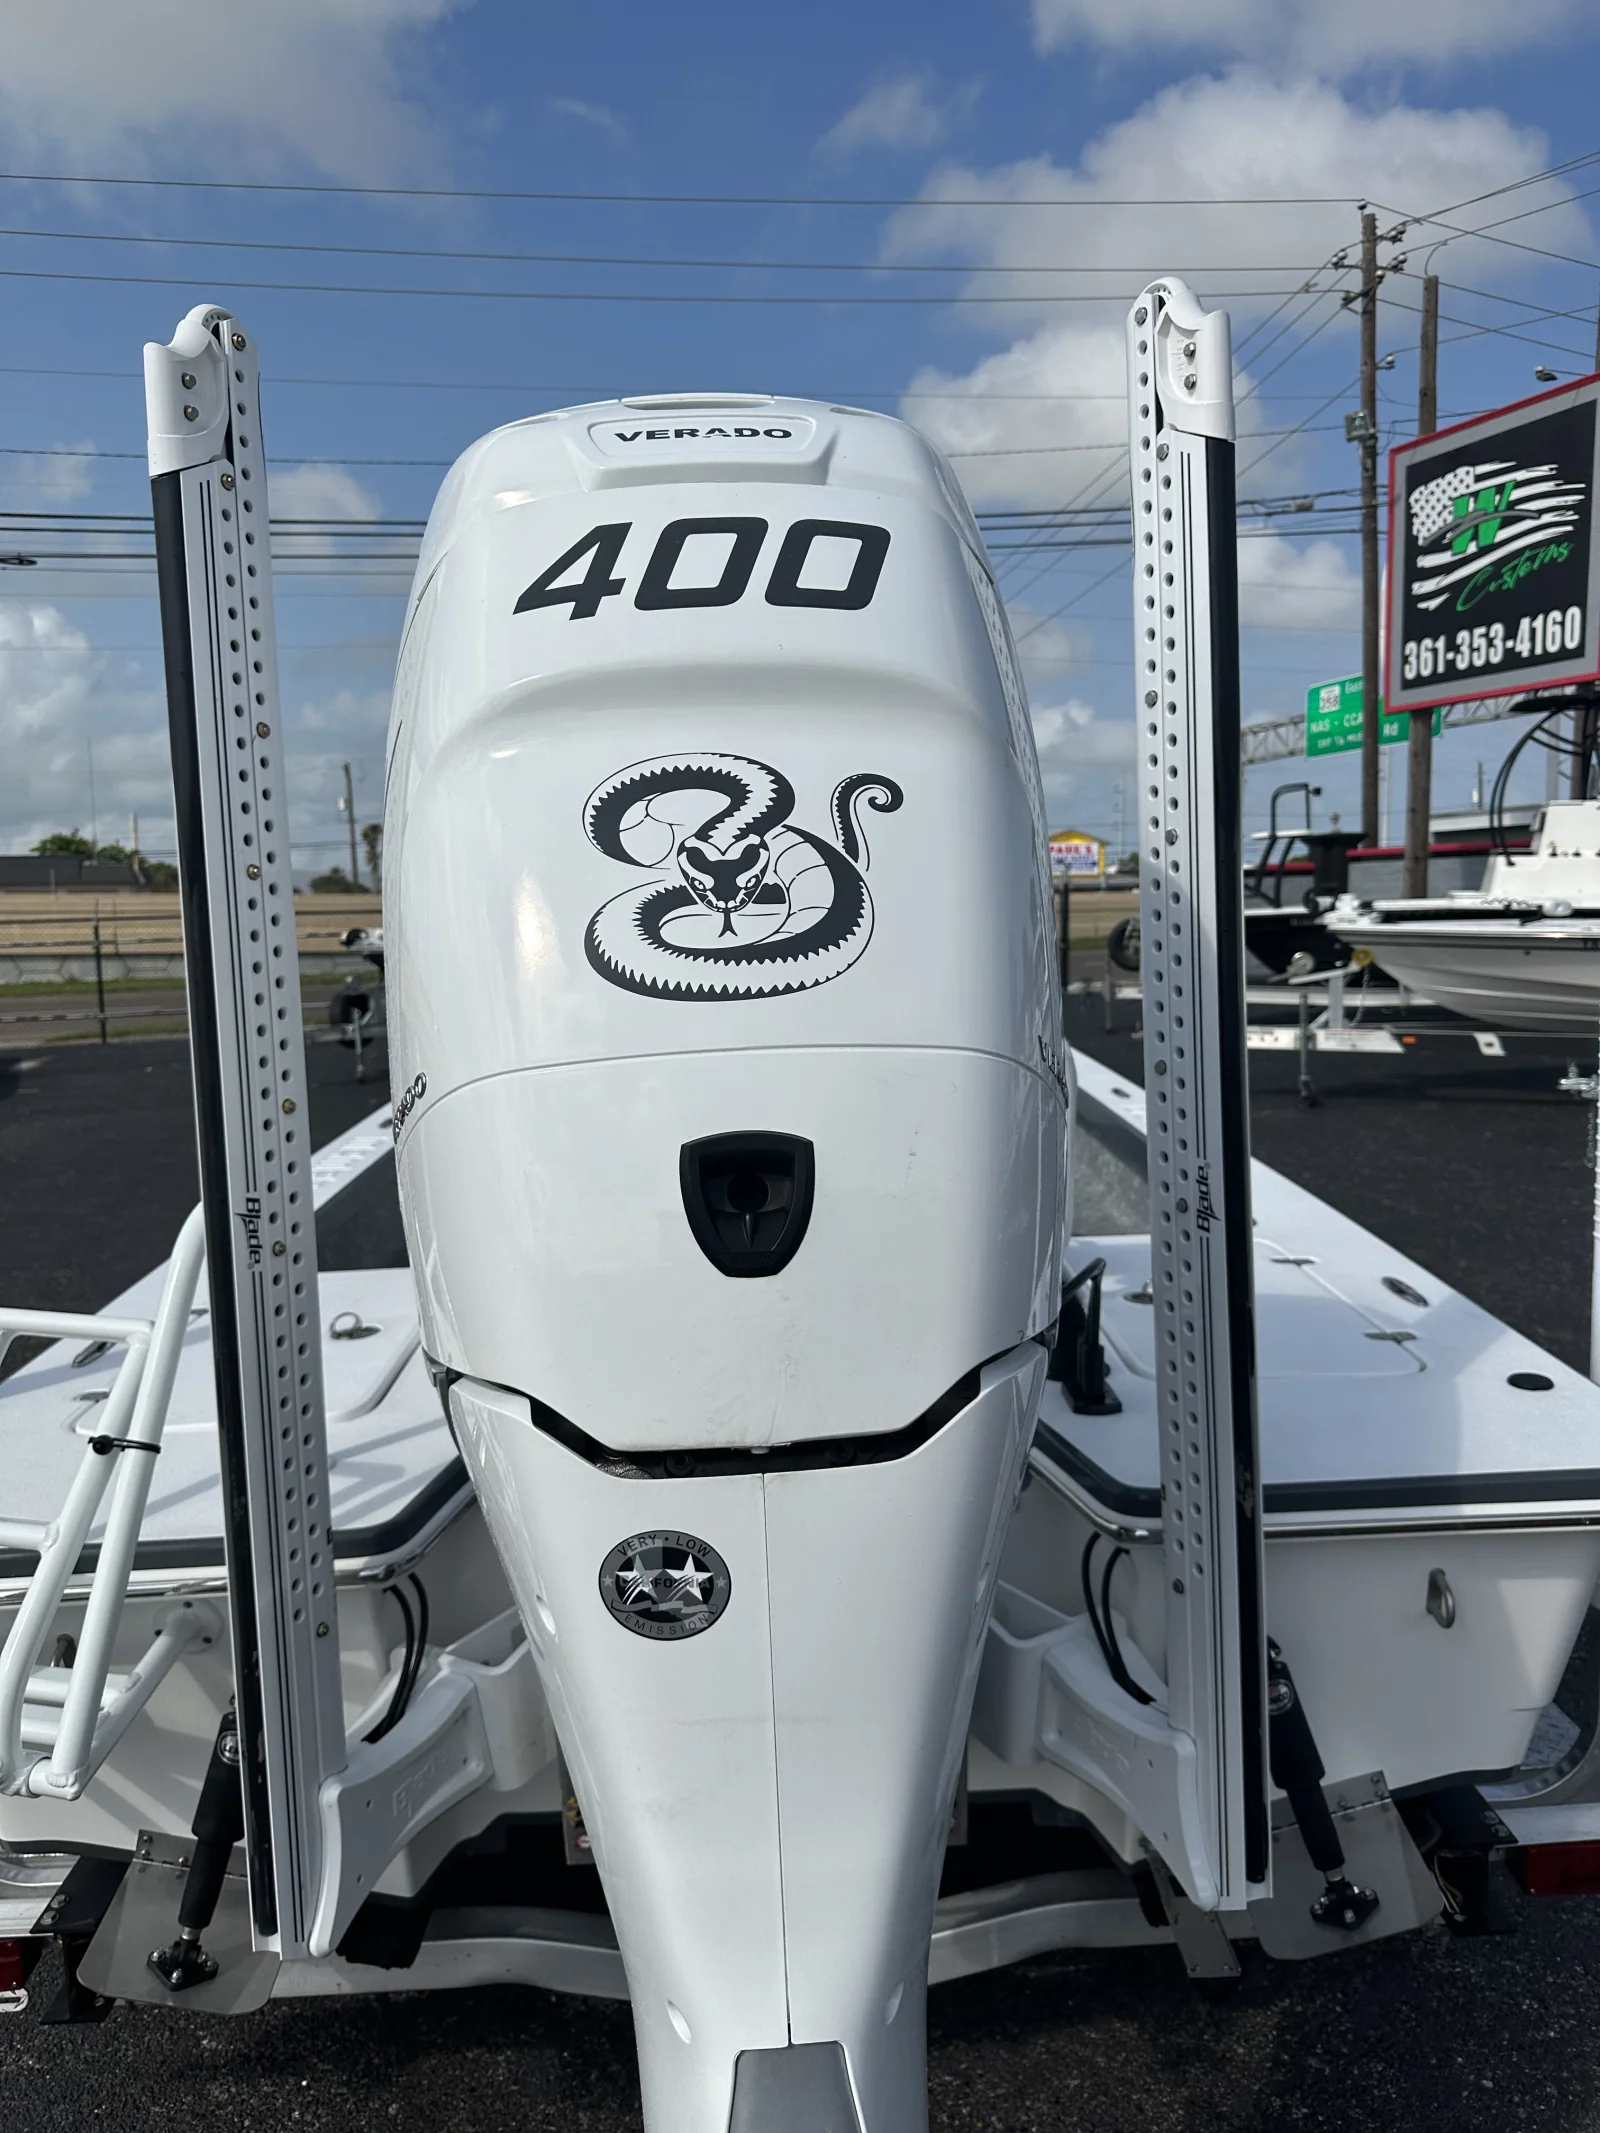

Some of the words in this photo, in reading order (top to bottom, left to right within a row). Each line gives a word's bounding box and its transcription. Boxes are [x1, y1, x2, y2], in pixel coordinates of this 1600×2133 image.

[614, 427, 793, 443] VERADO
[512, 516, 892, 621] 400
[1455, 540, 1573, 612] Customs
[1403, 605, 1582, 681] 361-353-4160
[233, 1197, 263, 1264] Blade
[1195, 1165, 1222, 1234] Blade
[617, 1534, 657, 1557] VERY
[675, 1535, 711, 1558] LOW
[624, 1613, 708, 1636] EMISSION
